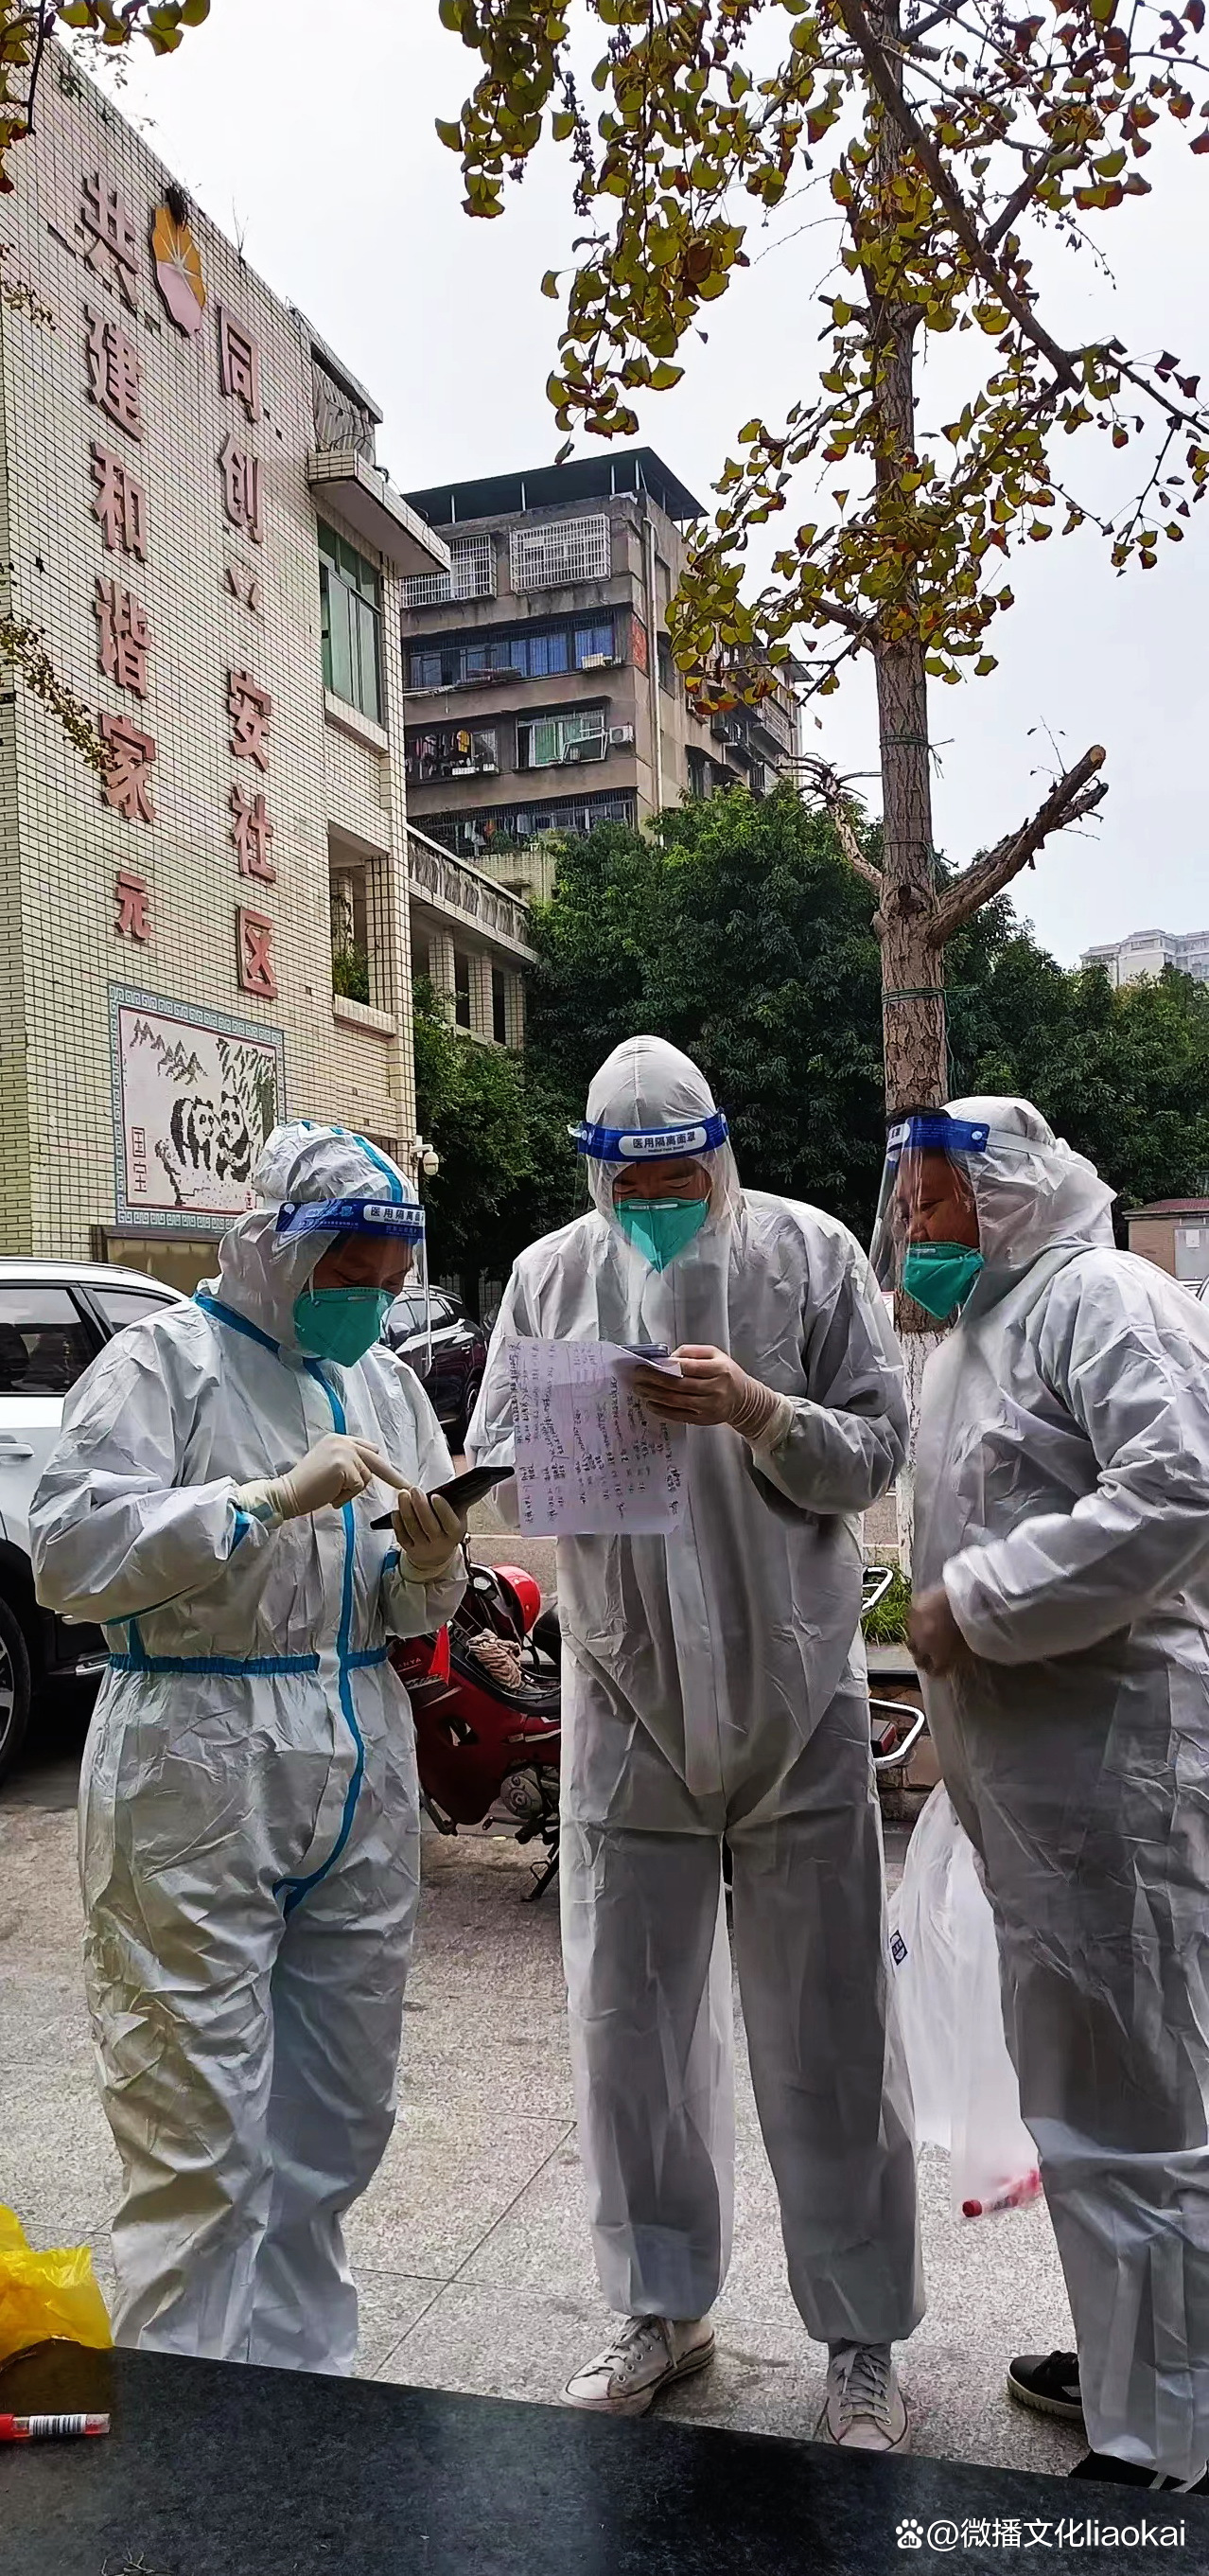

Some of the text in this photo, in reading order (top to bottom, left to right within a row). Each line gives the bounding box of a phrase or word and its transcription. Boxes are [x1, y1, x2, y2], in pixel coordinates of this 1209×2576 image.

[218, 305, 278, 999] 同创安社区
[632, 1131, 695, 1149] 医用隔离面罩
